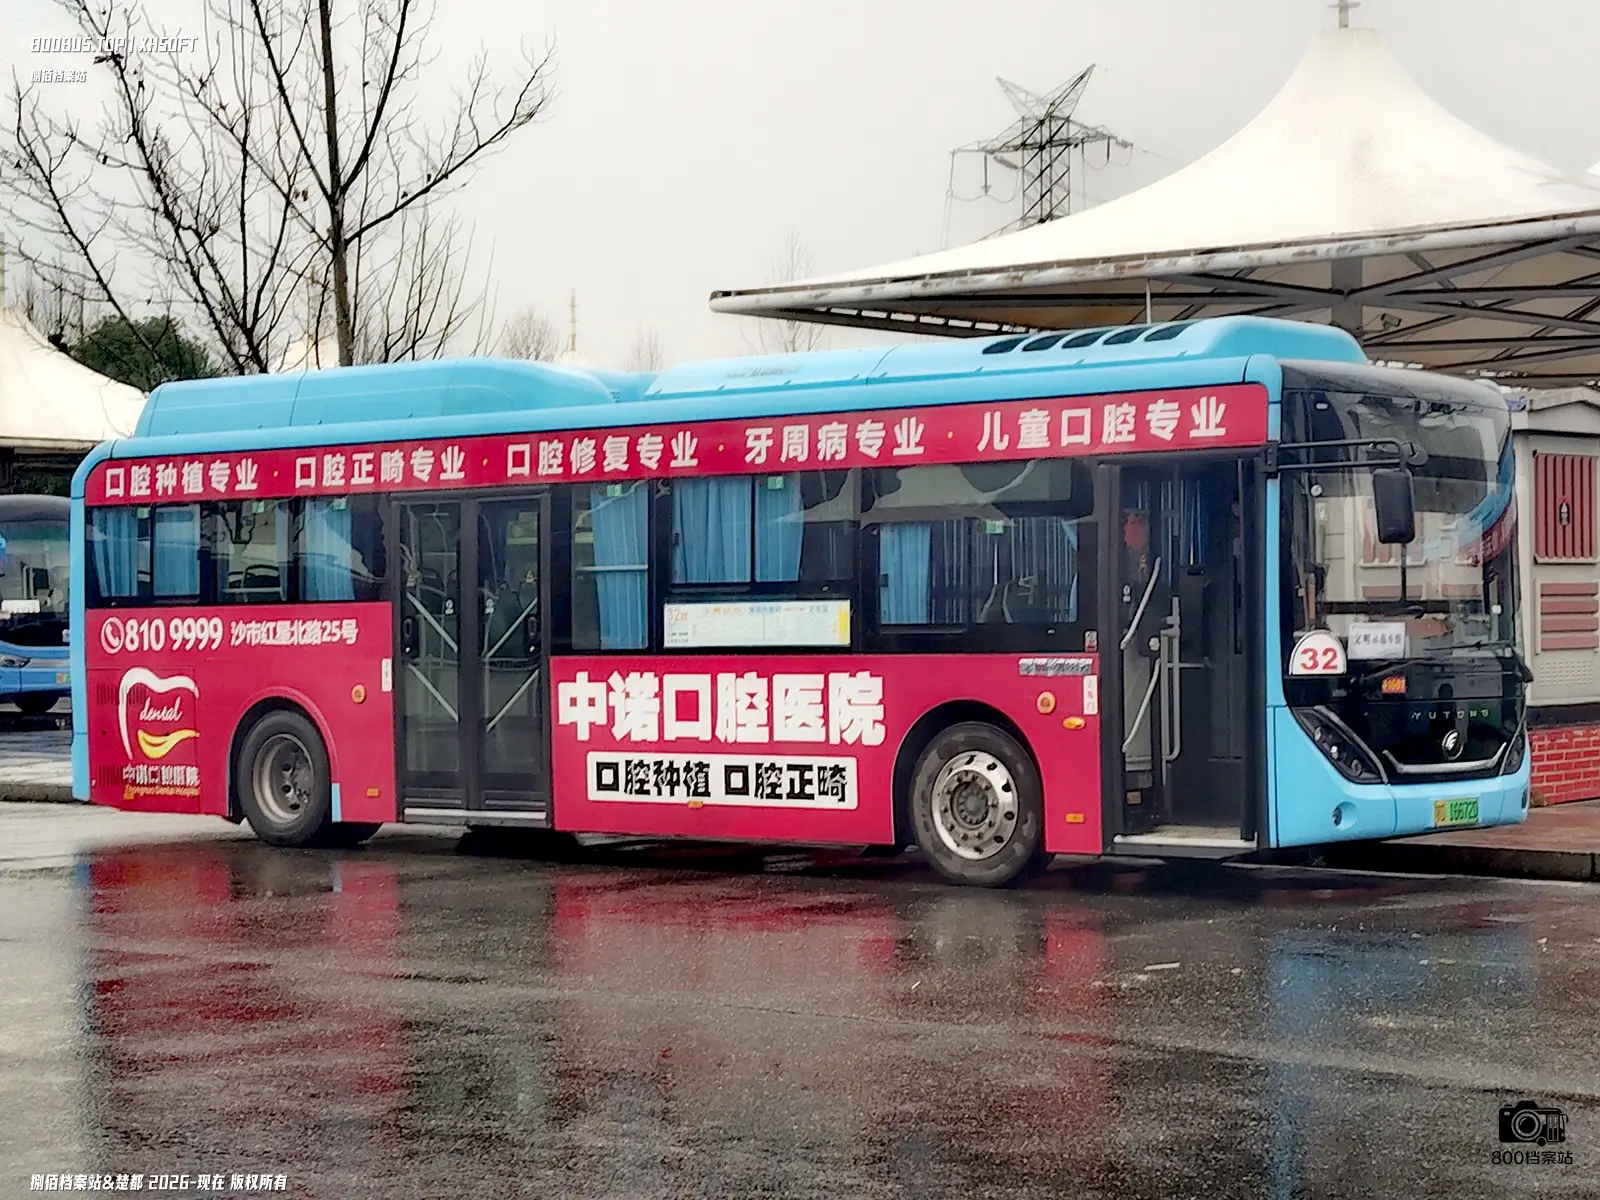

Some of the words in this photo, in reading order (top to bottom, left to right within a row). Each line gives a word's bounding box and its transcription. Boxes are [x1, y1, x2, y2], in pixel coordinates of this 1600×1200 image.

[104, 457, 259, 499] 口腔种植专业
[295, 446, 466, 488] 口腔正畸专业
[506, 430, 699, 478] 口腔修复专业
[744, 416, 926, 464] 牙周病专业
[976, 396, 1227, 452] 儿童口腔专业
[125, 617, 165, 651] 810
[169, 616, 223, 651] 9999
[1300, 647, 1339, 671] 32
[557, 669, 887, 747] 中诺口腔医院
[1410, 708, 1490, 721] YUTONG
[595, 759, 712, 799] 口腔种植
[723, 762, 848, 803] 口腔正畸
